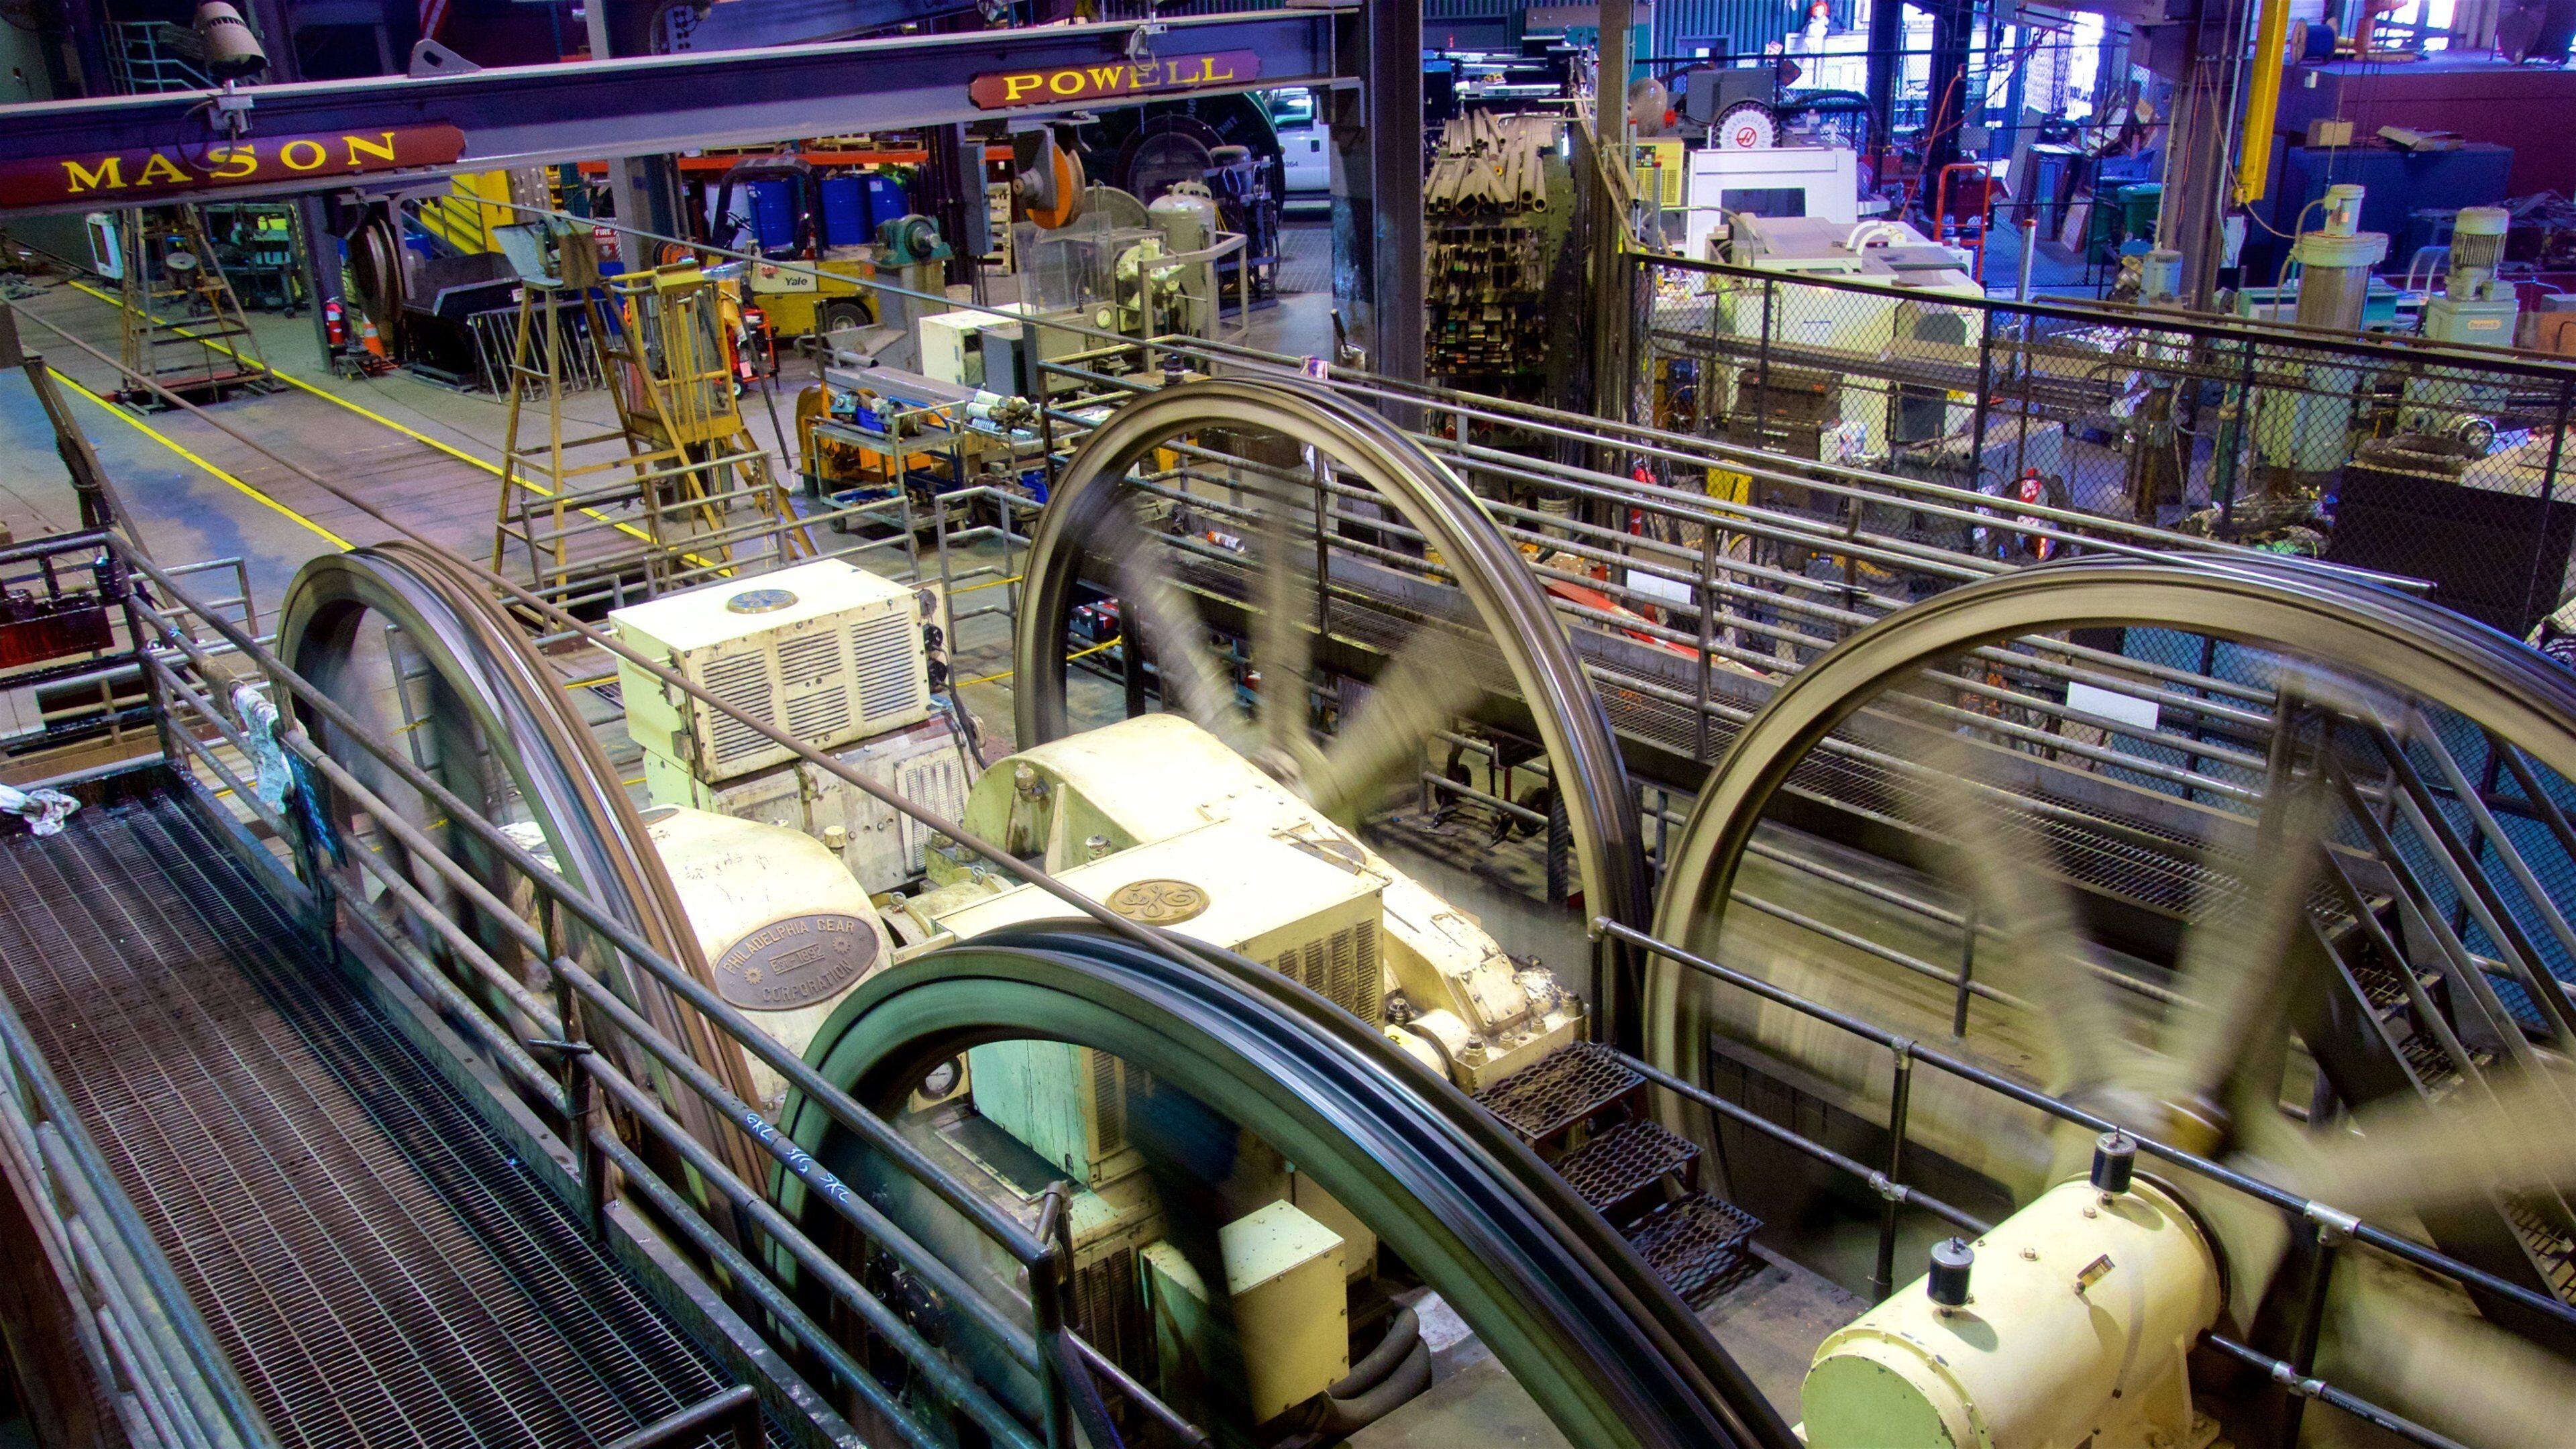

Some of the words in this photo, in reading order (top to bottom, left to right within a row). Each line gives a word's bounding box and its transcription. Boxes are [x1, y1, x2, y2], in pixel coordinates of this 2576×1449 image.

[1003, 58, 1234, 101] POWELL
[61, 131, 396, 193] MASON
[785, 277, 808, 286] Yale
[723, 921, 810, 975] PHILADELPHIA
[816, 918, 855, 935] GEAR
[761, 959, 854, 1002] CORPORATION
